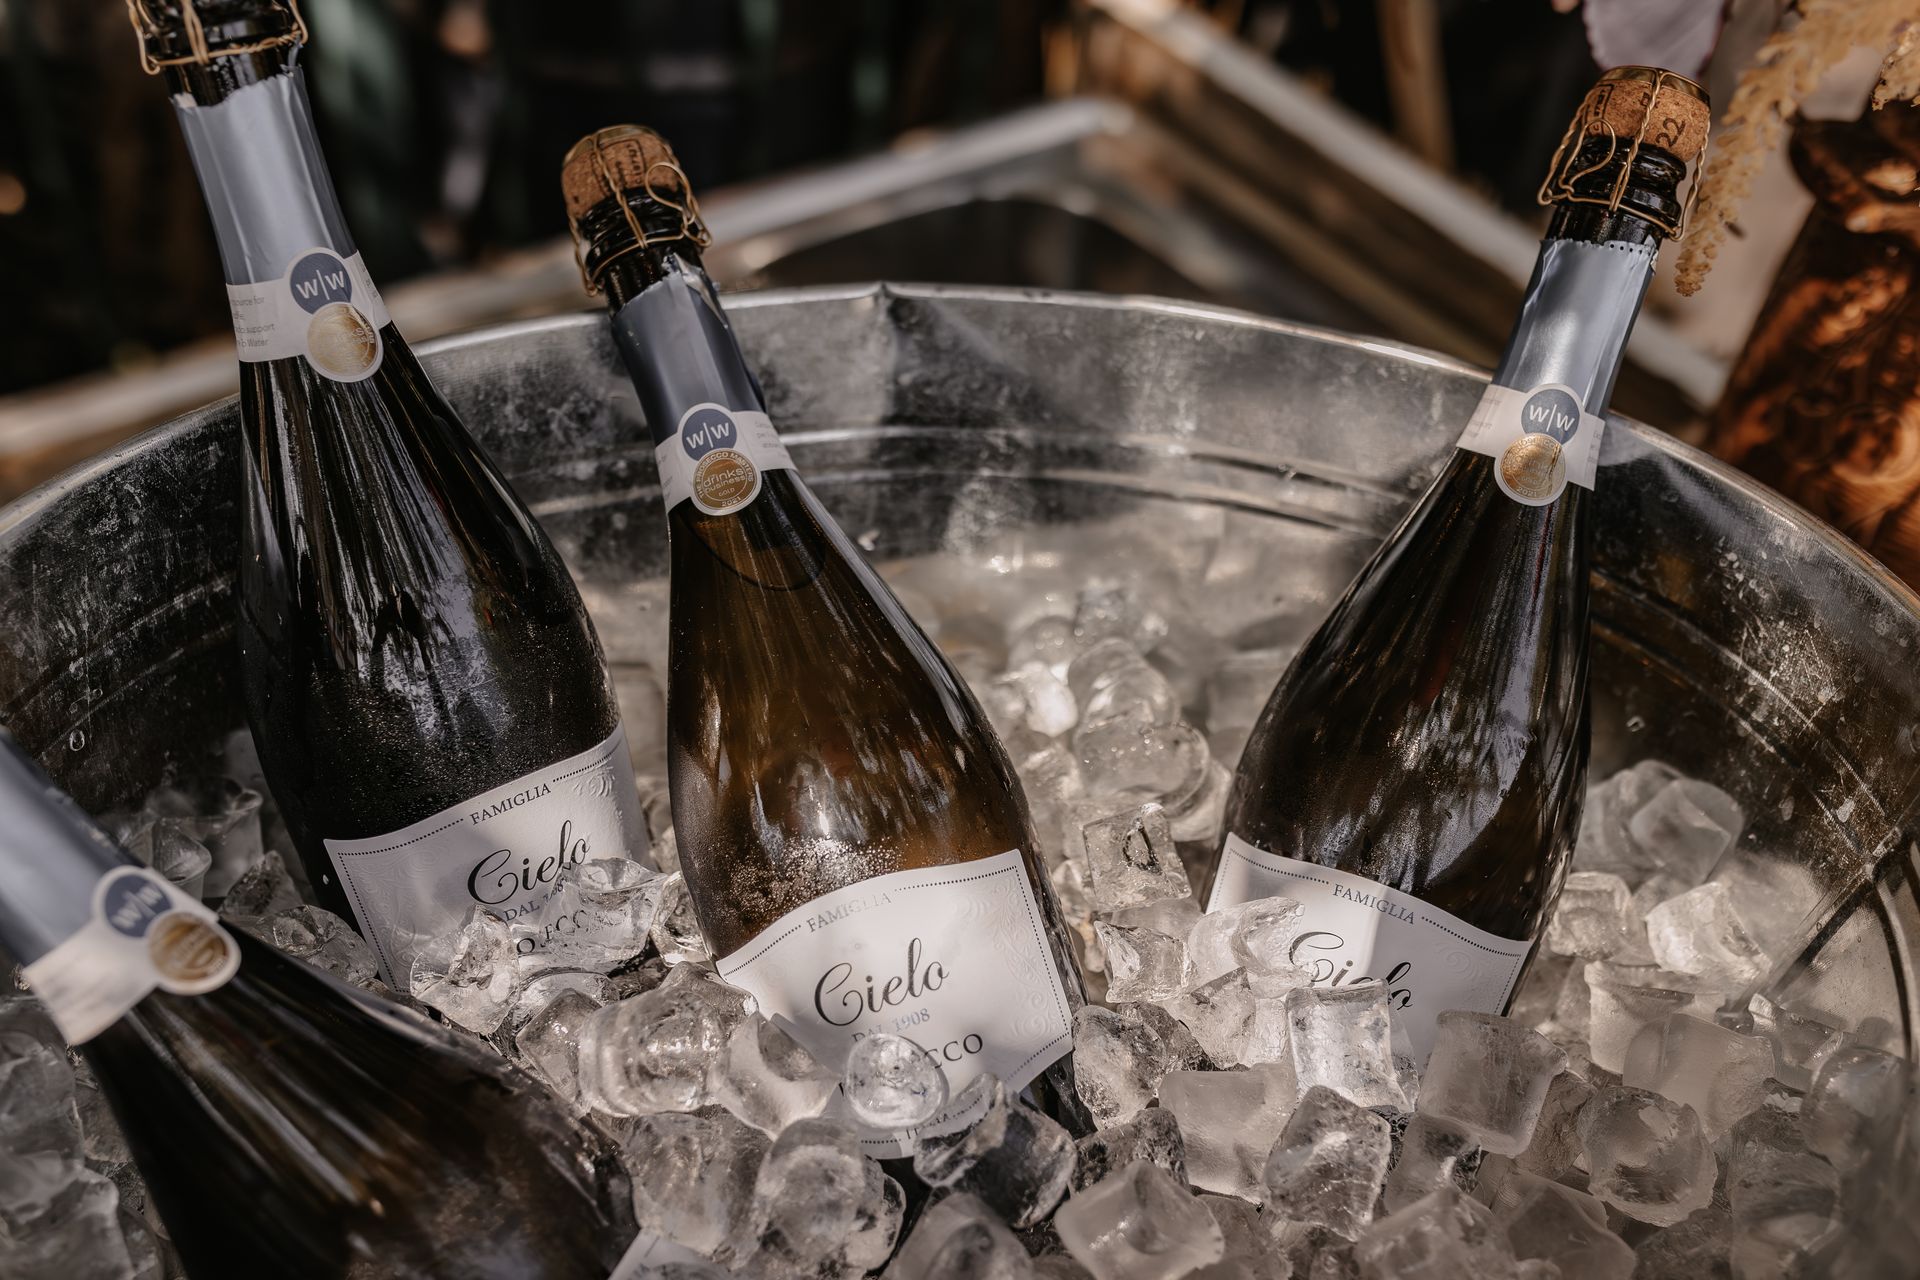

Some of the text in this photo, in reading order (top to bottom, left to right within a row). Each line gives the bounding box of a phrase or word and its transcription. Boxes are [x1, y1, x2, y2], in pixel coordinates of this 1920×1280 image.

[703, 468, 744, 488] drinks
[469, 781, 552, 827] FAMIGLIA
[466, 819, 591, 906] Cielo
[503, 898, 541, 923] DAL
[805, 890, 893, 934] FAMIGLIA
[1331, 883, 1416, 925] FAMIGLIA
[813, 937, 950, 1027] Cielo
[892, 1007, 932, 1034] 1908
